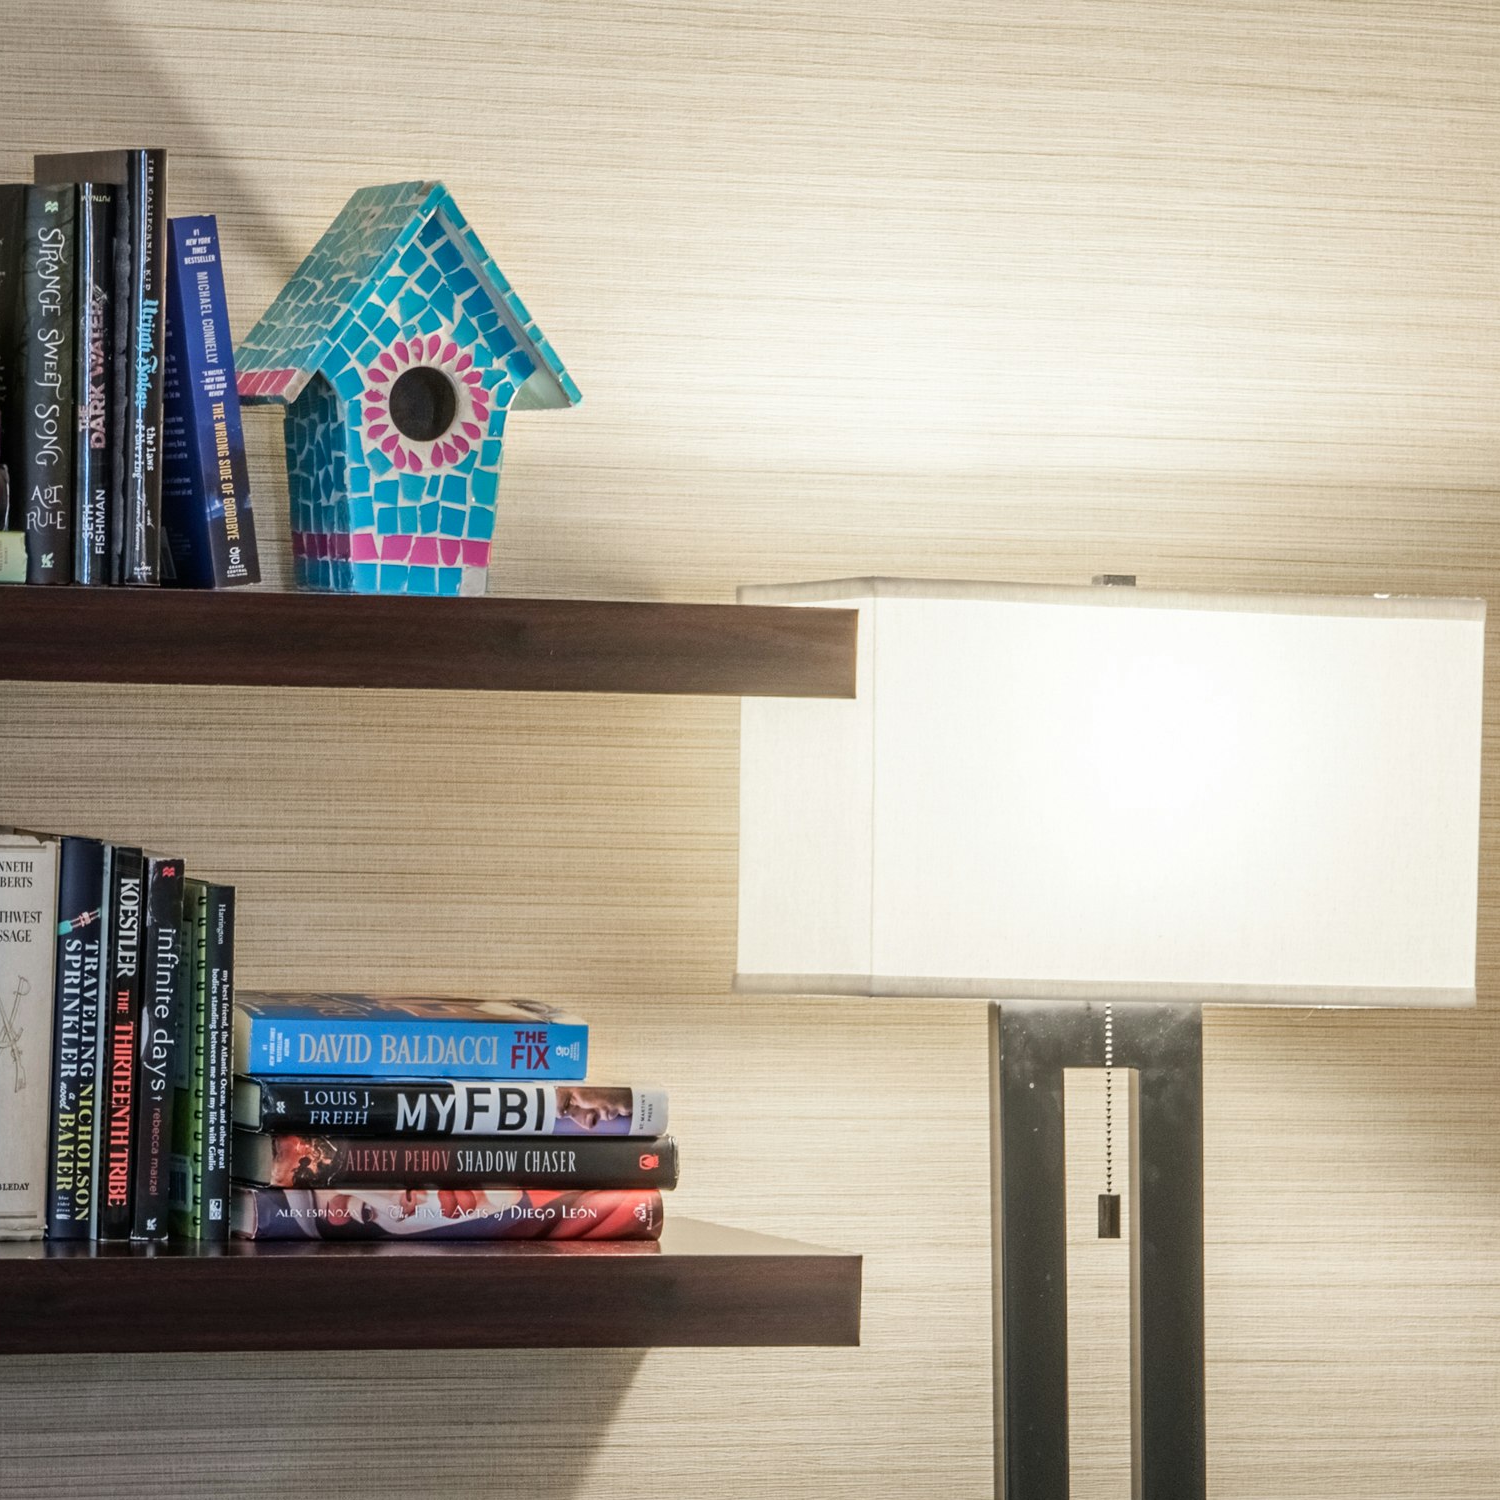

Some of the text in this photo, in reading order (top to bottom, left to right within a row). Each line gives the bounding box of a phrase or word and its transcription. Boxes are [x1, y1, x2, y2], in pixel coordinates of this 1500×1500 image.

[184, 254, 216, 265] BESTSELLER
[185, 236, 211, 246] NEW YORK
[192, 246, 207, 255] TIMES
[196, 271, 219, 364] MICHAEL CONNELLY
[211, 401, 240, 541] THE SIDE GOODBYE
[95, 489, 106, 555] FISHMAN
[116, 877, 140, 979] KOESTLER
[216, 903, 226, 945] Harrington
[153, 926, 180, 1021] infinite
[60, 938, 82, 1078] SPRINKLER
[80, 938, 99, 1077] TRAVELING
[298, 1033, 499, 1066] DAVID BALDACCI
[510, 1045, 550, 1071] FIX
[514, 1030, 547, 1044] THE
[208, 968, 220, 1171] bodies standing between and life with Giulio
[219, 984, 229, 1147] best the Atlantic and other
[107, 989, 134, 1207] THE THIRTEENTH TRIBE
[304, 1090, 375, 1109] LOUIS J.
[309, 1110, 368, 1126] FREEH
[56, 1113, 76, 1192] BAKER
[74, 1083, 94, 1220] NICHOLSON
[151, 1107, 162, 1154] rebecca
[346, 1149, 577, 1173] ALEXEY PEHOV SHADOW CHASER
[276, 1204, 489, 1219] ALEX ACTS
